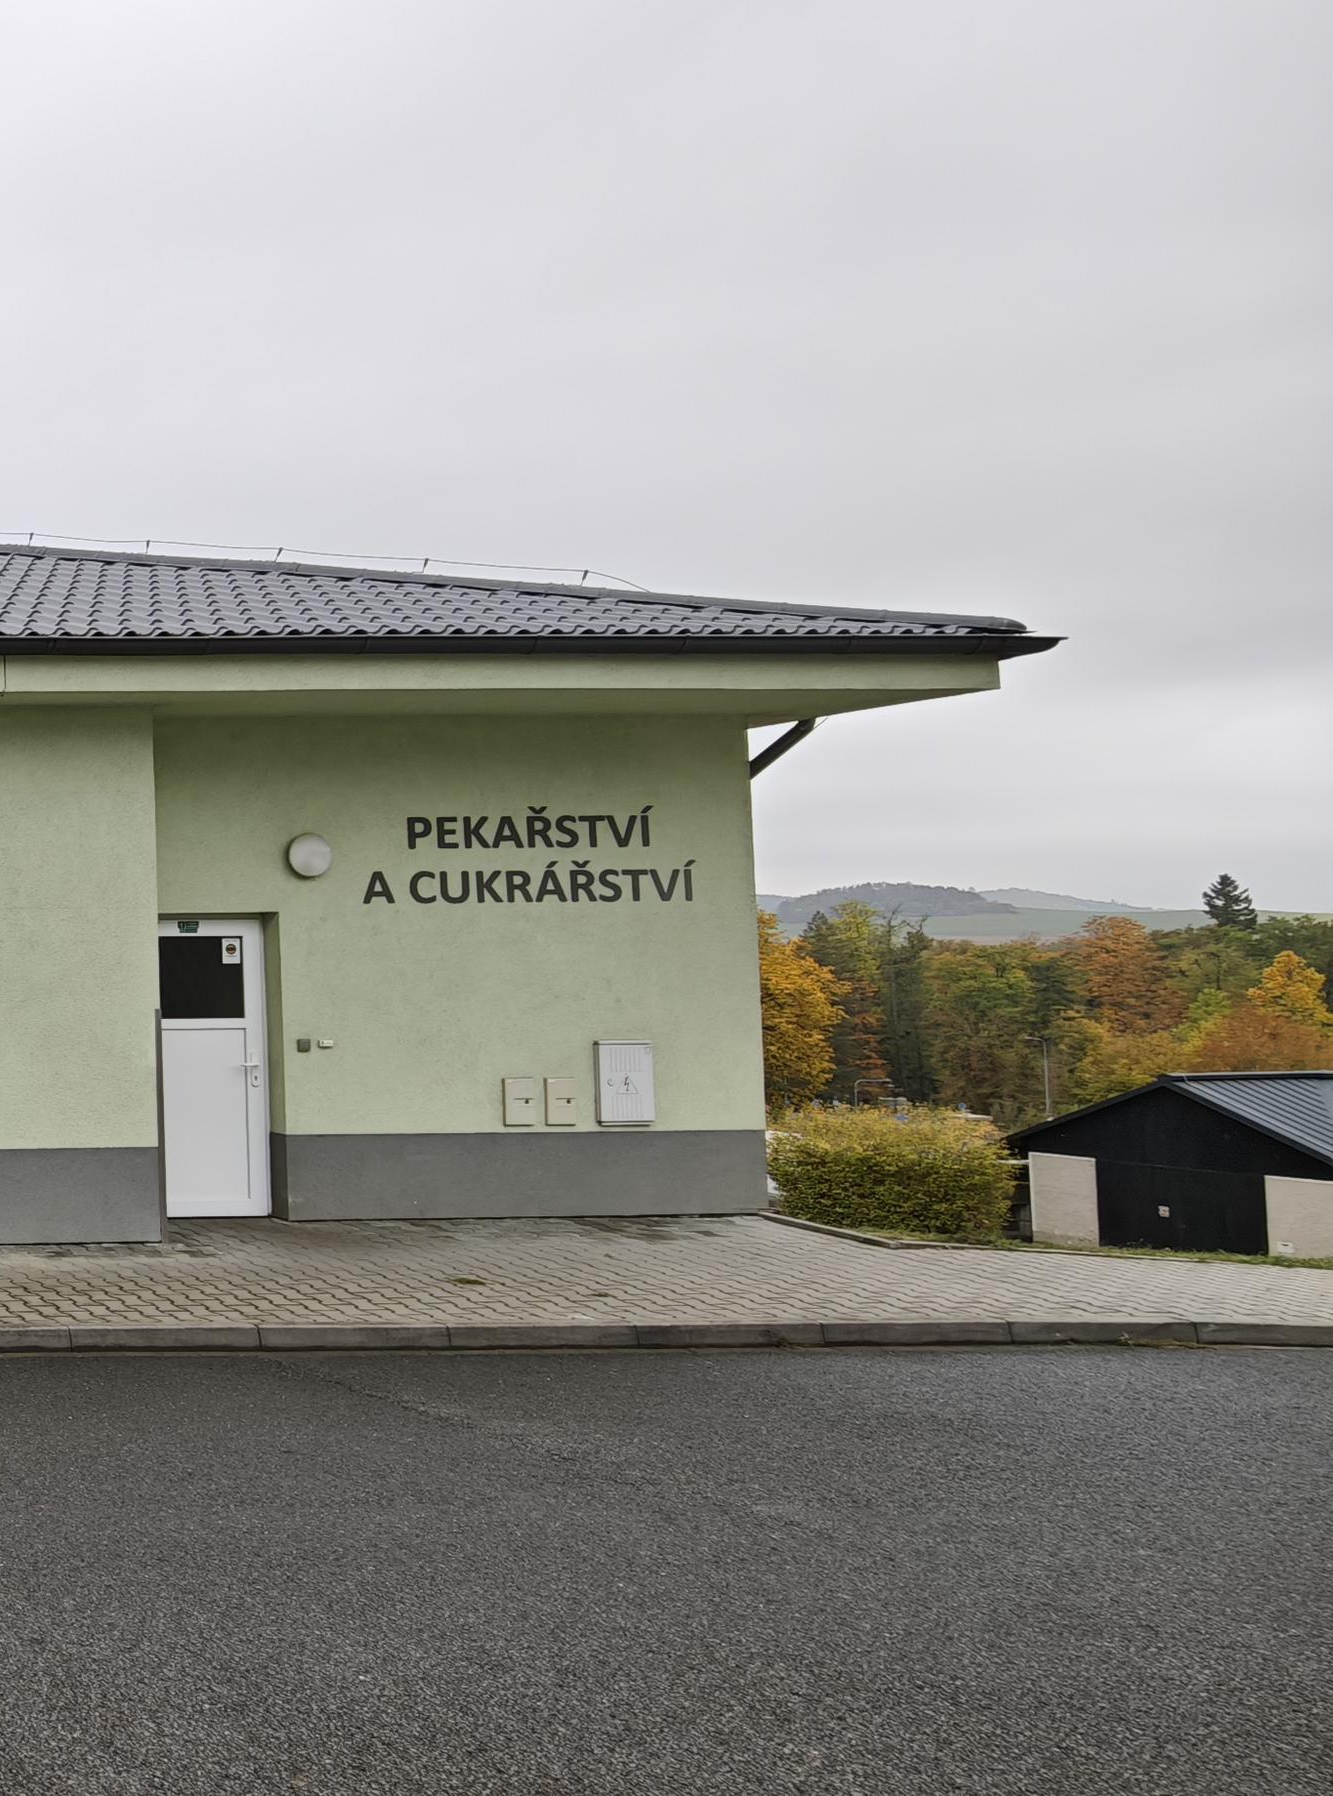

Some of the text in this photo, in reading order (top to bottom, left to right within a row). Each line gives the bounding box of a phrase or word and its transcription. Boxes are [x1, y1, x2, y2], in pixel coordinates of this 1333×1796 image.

[406, 805, 653, 849] PEKAŘSTVÍ
[363, 860, 696, 904] A CUKRÁŘSTVÍ
